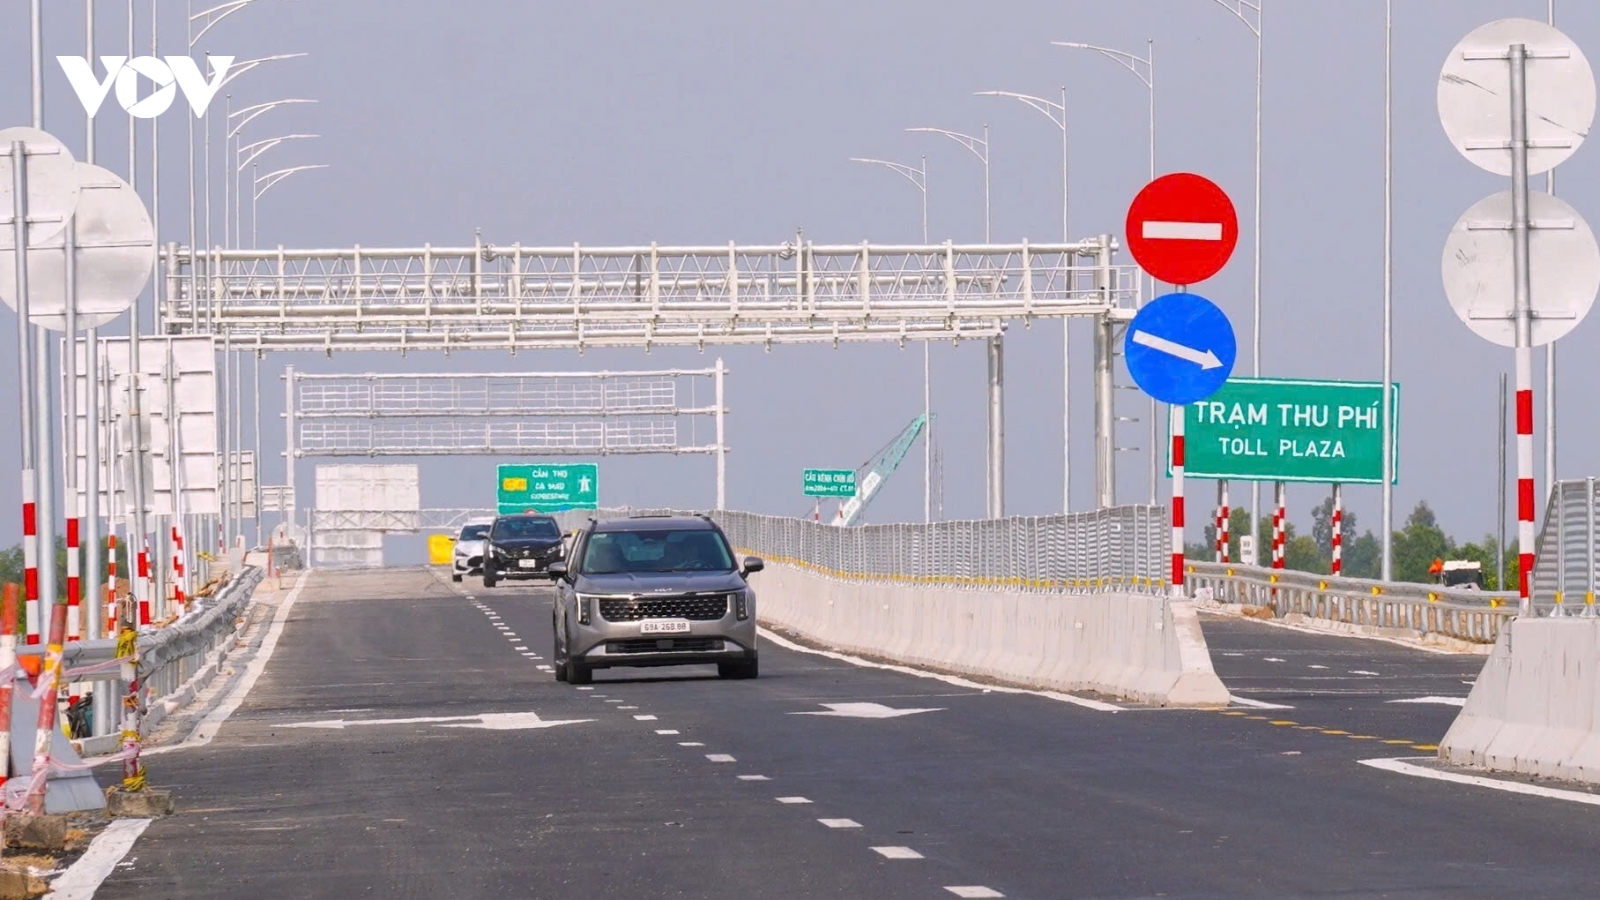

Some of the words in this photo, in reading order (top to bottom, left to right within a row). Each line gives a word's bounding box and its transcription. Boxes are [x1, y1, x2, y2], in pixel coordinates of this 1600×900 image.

[1193, 401, 1268, 430] TRẠM
[1277, 403, 1329, 427] THU
[1338, 400, 1380, 429] PHÍ
[1219, 437, 1268, 455] TOLL
[1279, 439, 1346, 458] PLAZA
